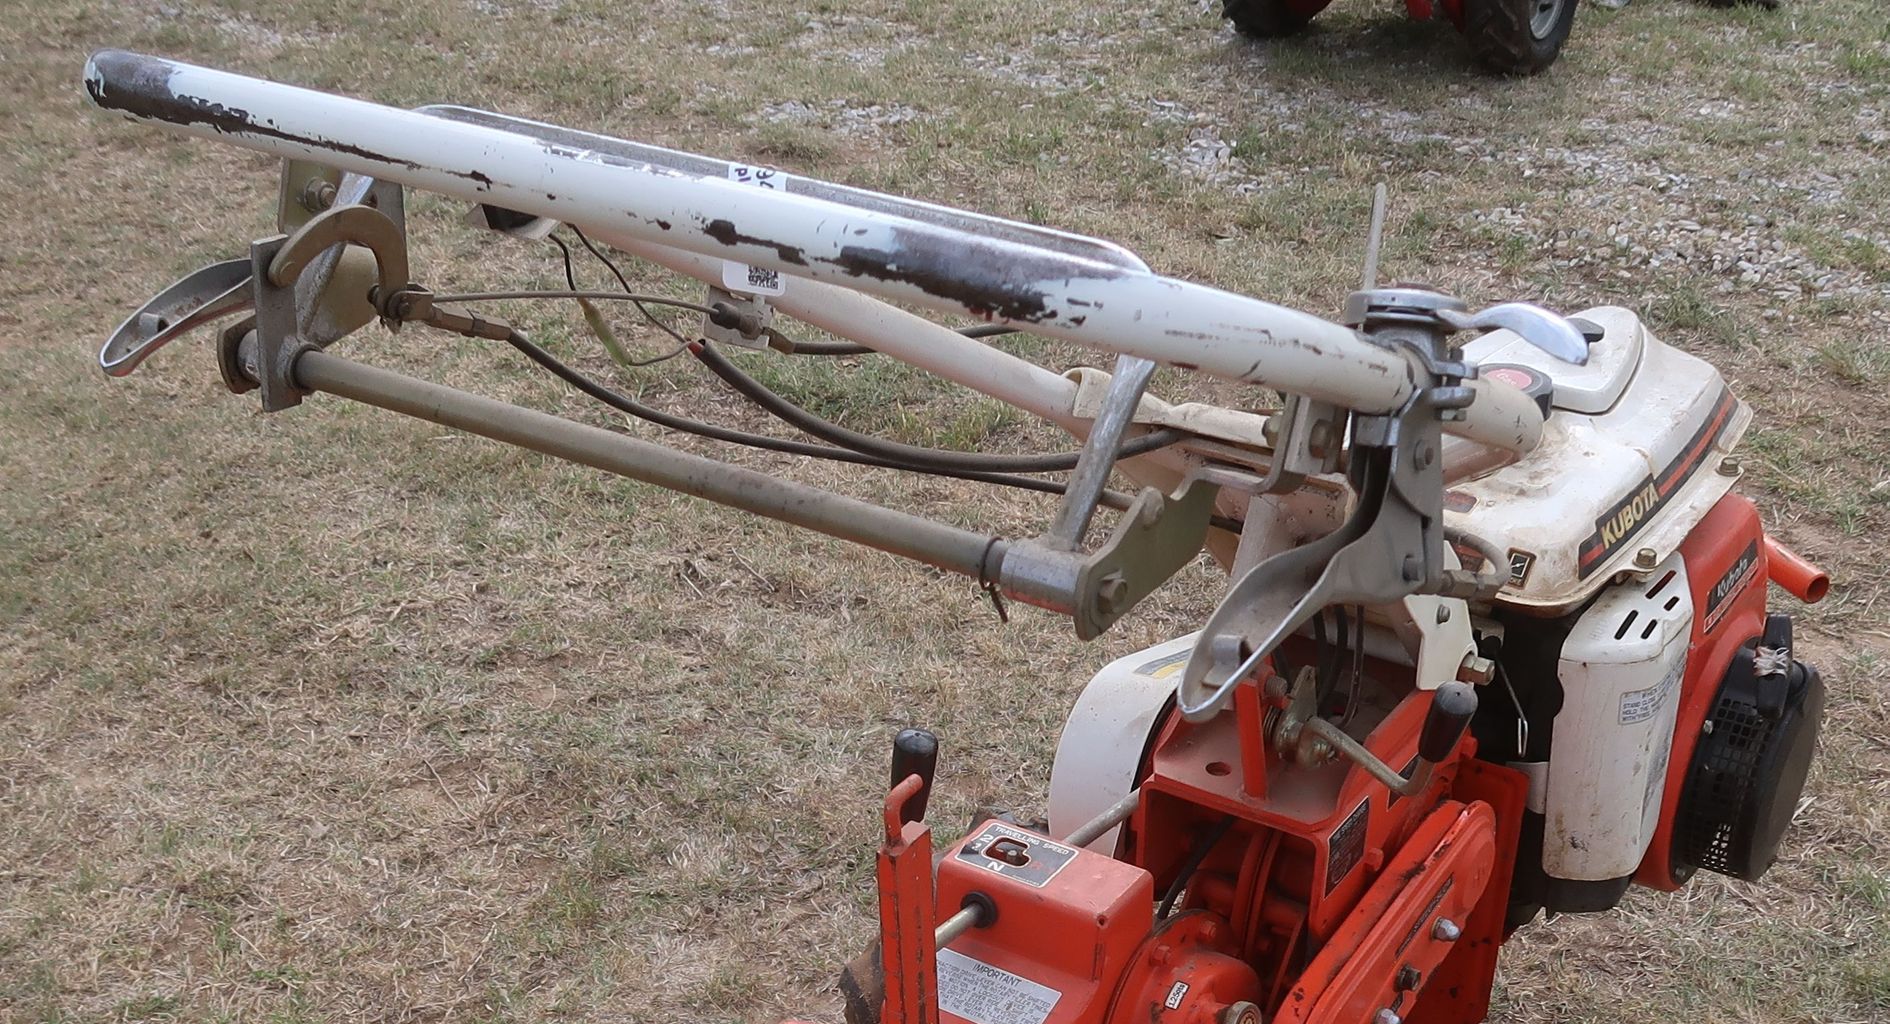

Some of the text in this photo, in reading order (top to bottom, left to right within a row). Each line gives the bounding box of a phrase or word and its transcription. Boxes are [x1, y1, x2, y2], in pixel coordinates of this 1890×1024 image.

[1601, 482, 1659, 549] KUBOTA
[979, 834, 994, 842] 2
[994, 826, 1069, 854] TRAVELLING SPEED
[987, 861, 1004, 870] N
[972, 963, 1021, 986] IMPORTANT
